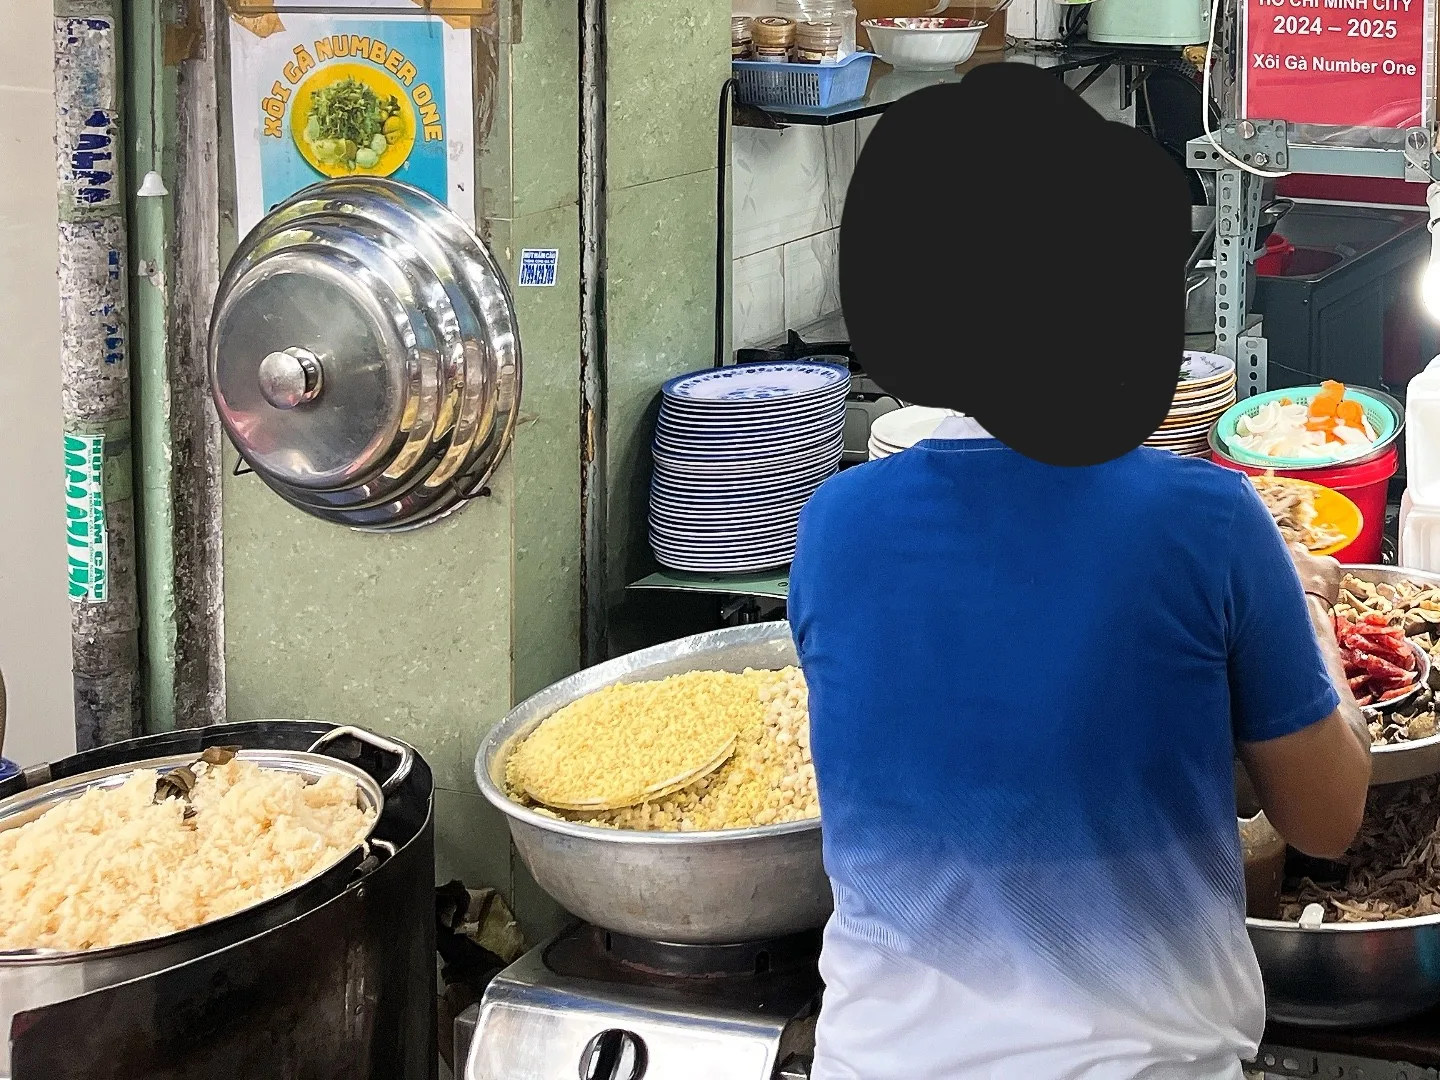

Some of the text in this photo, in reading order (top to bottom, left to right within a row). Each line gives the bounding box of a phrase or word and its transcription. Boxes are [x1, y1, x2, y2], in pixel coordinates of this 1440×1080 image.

[1273, 15, 1322, 35] 2024
[1347, 18, 1397, 39] 2025
[1253, 53, 1416, 76] Xôi Gà Number One
[314, 34, 418, 86] NUMBER
[412, 83, 443, 143] ONE
